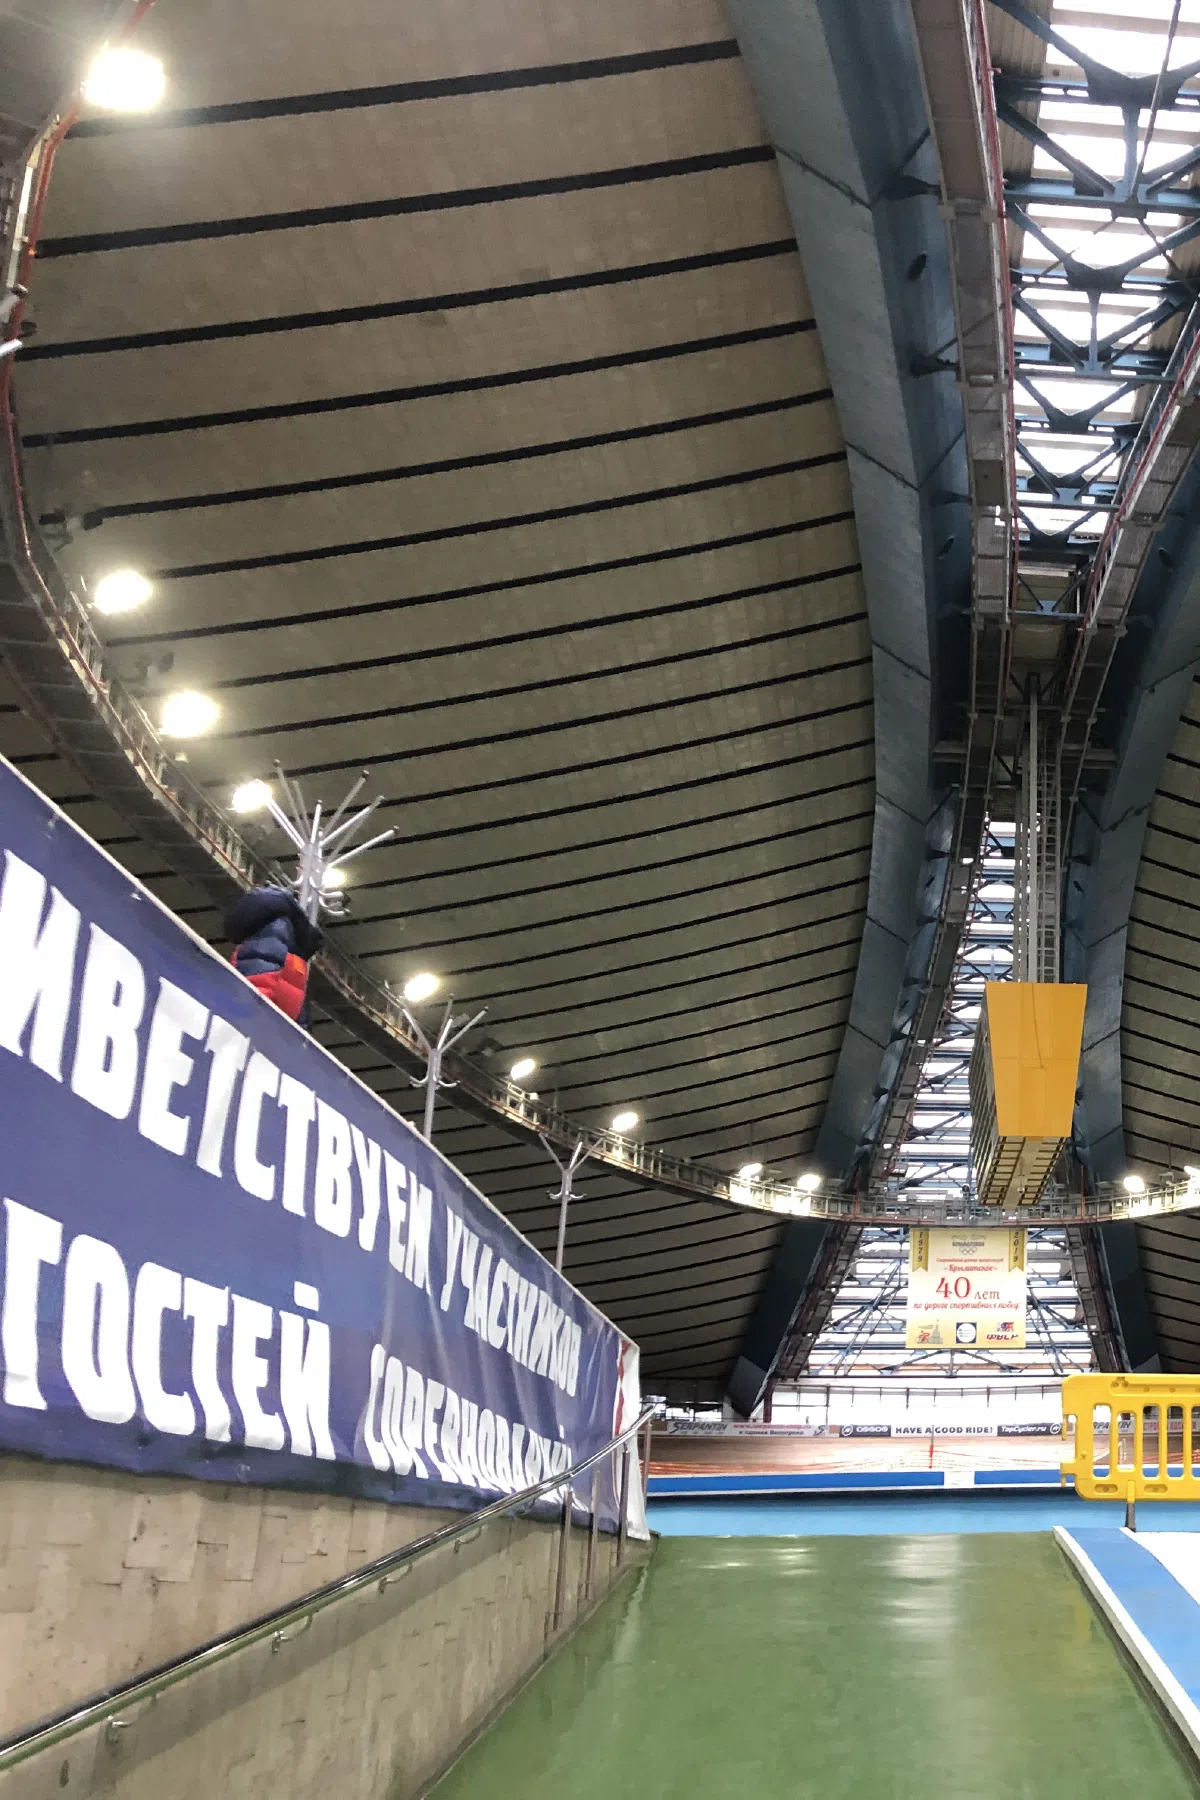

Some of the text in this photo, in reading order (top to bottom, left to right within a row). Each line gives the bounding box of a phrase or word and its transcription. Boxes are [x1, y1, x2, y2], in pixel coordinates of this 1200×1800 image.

[0, 849, 582, 1397] ИВЕТСТВУЕМ УЧАСТНИКОВ
[2, 1198, 337, 1460] ГОСТЕЙ
[936, 1276, 1001, 1300] 40 лет
[965, 1426, 993, 1434] RIDE!
